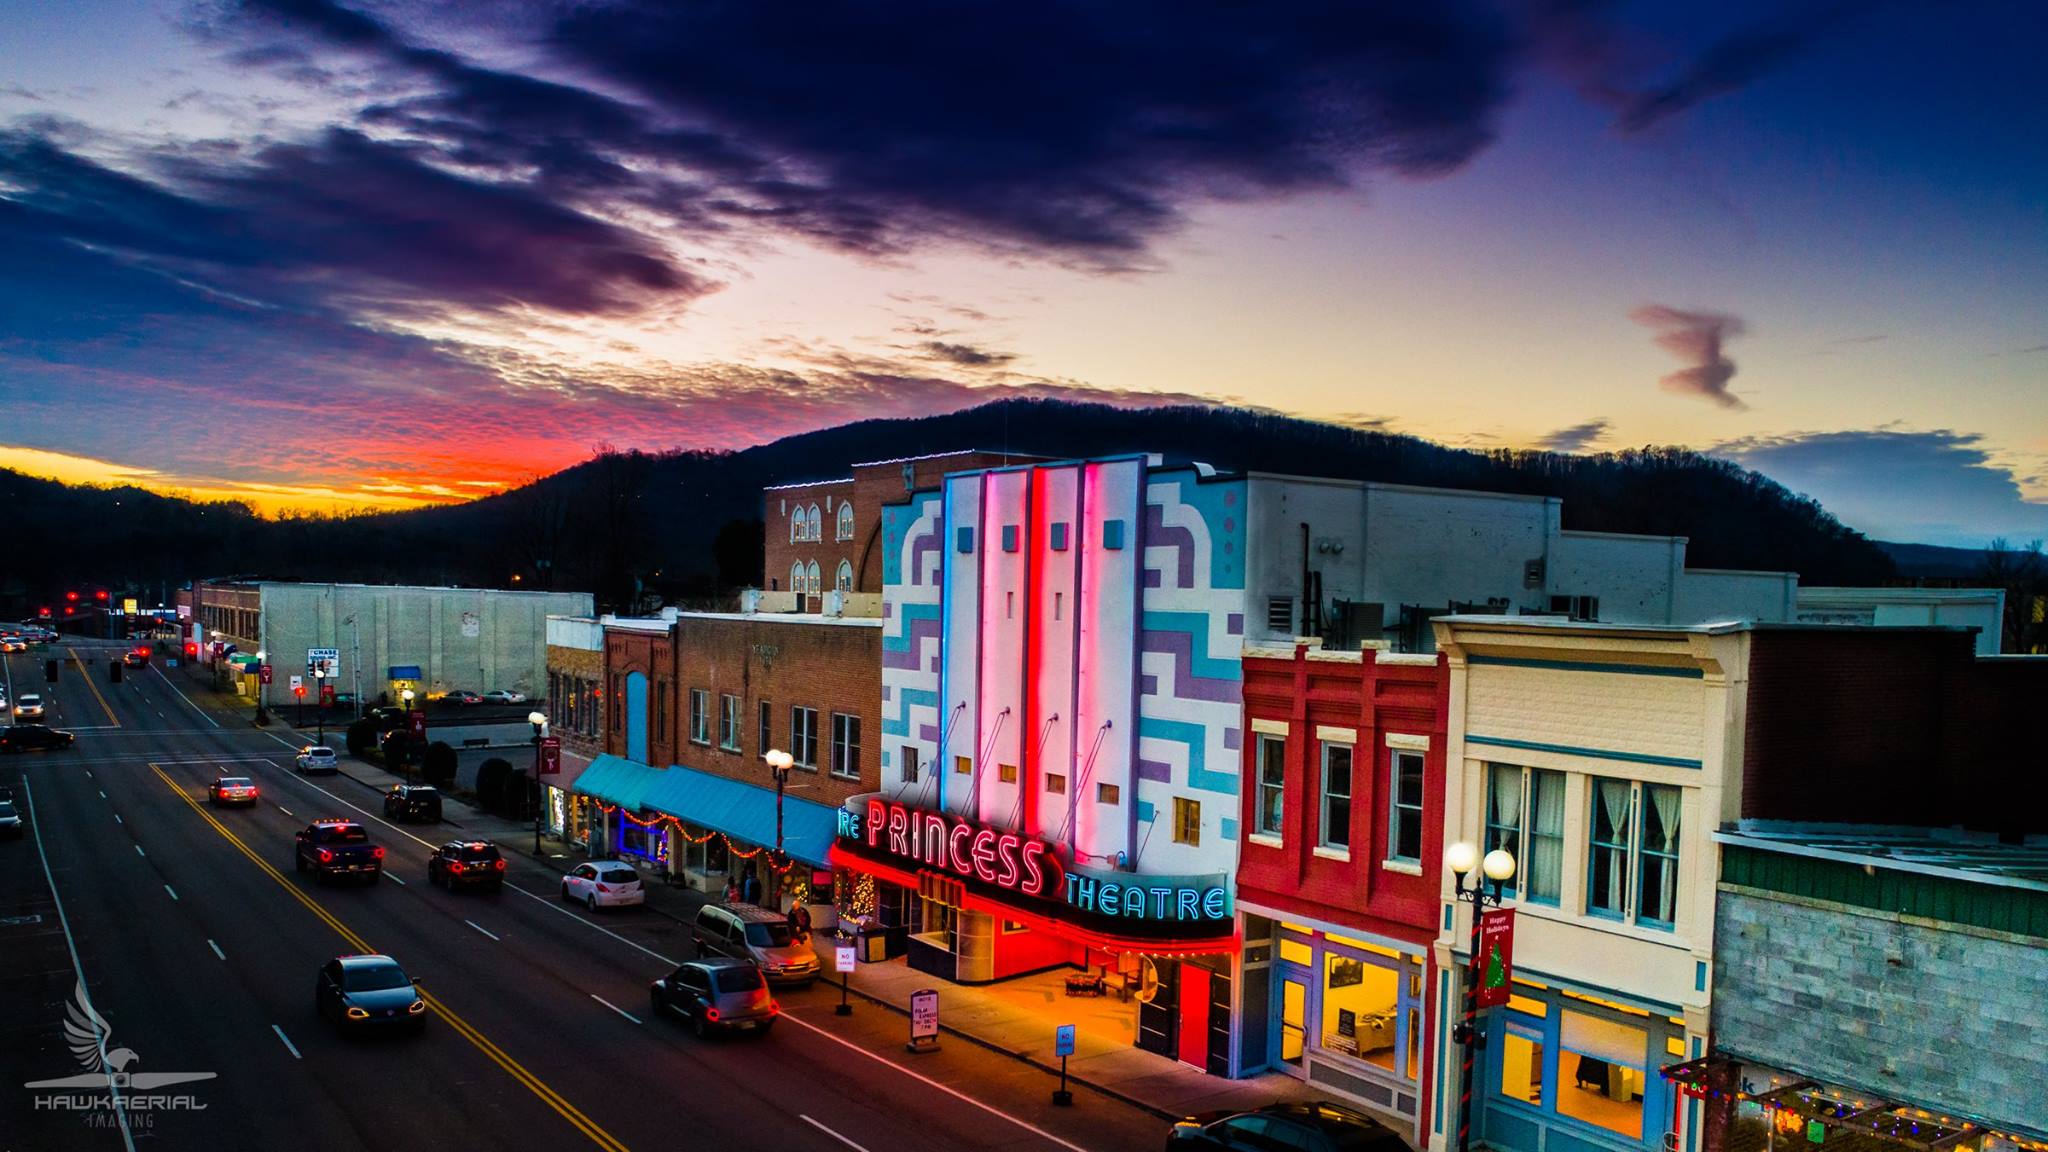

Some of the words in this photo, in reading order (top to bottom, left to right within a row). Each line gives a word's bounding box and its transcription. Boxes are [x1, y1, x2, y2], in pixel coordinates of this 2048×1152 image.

[867, 799, 1045, 895] PRINCESS
[1064, 872, 1226, 921] THEATRE
[1486, 925, 1509, 934] Holidays
[1489, 916, 1506, 924] Happy
